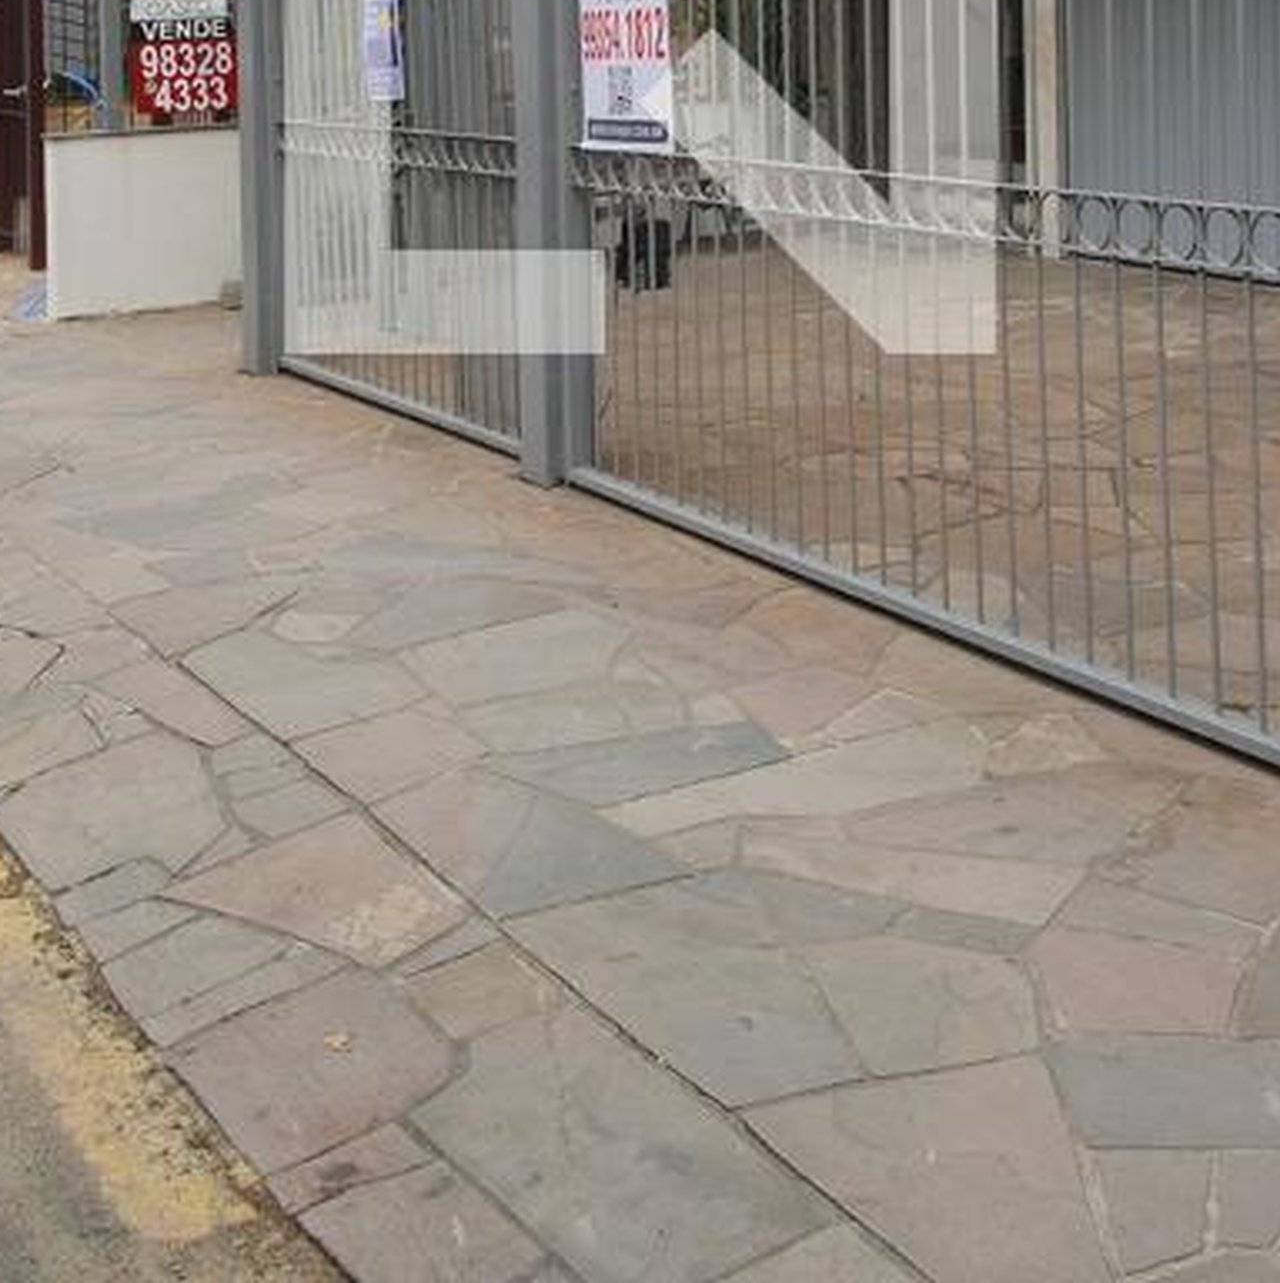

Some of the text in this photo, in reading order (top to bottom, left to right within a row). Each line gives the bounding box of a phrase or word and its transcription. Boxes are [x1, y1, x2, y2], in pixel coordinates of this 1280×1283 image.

[140, 18, 227, 41] VENDE
[140, 42, 233, 79] 98328
[154, 76, 229, 112] 4333
